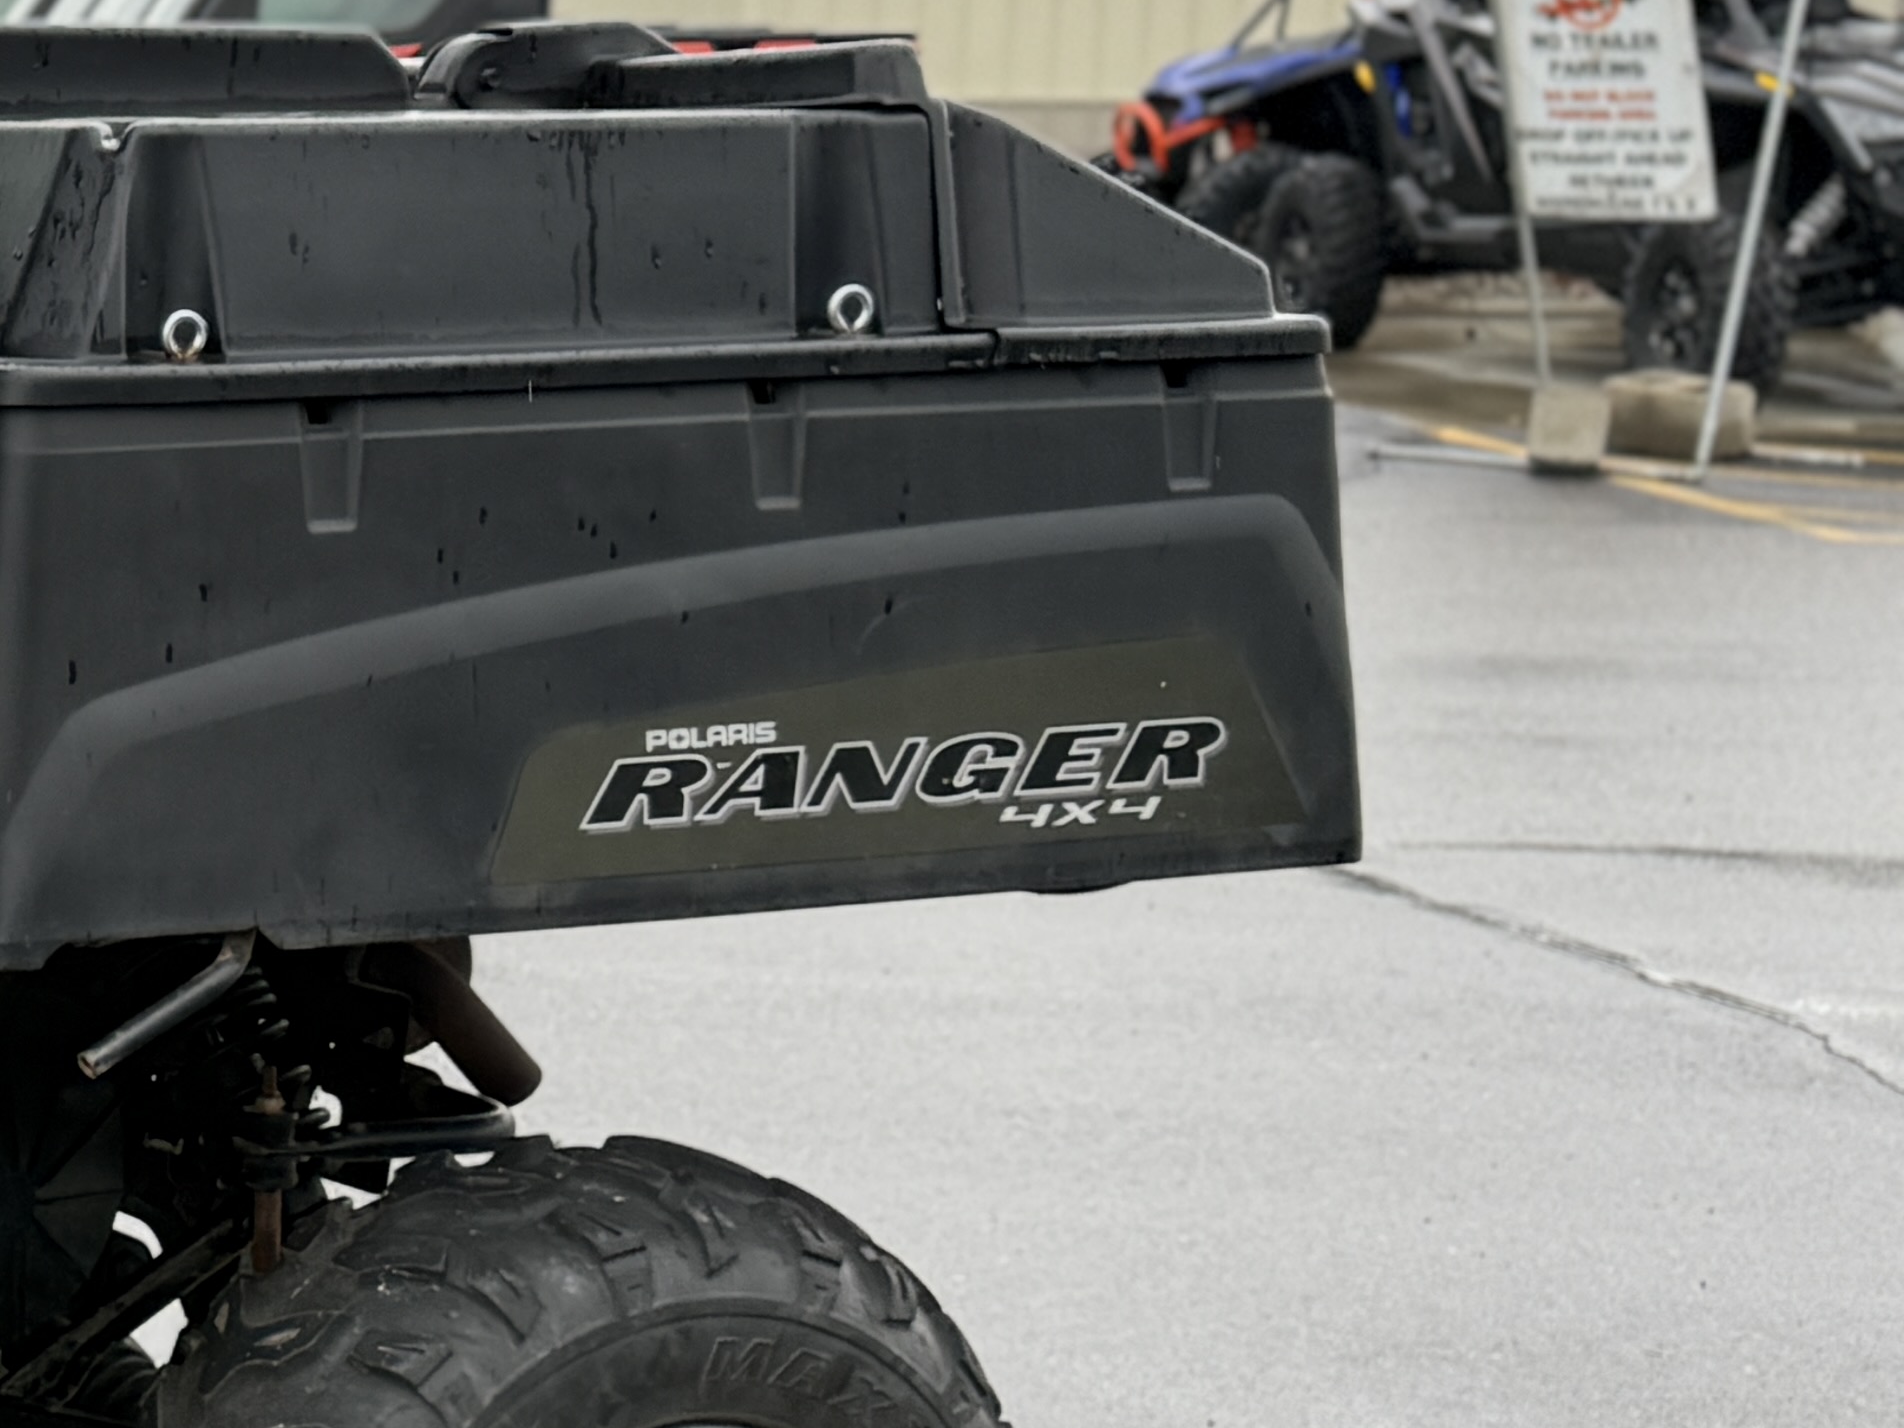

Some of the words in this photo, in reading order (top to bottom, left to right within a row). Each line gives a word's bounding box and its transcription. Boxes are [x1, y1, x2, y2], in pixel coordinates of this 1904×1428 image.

[1530, 32, 1562, 50] NO
[1570, 32, 1659, 50] TRAILER
[1549, 59, 1646, 77] PARKING
[645, 721, 777, 753] POLARIS
[578, 716, 1230, 836] RANGER
